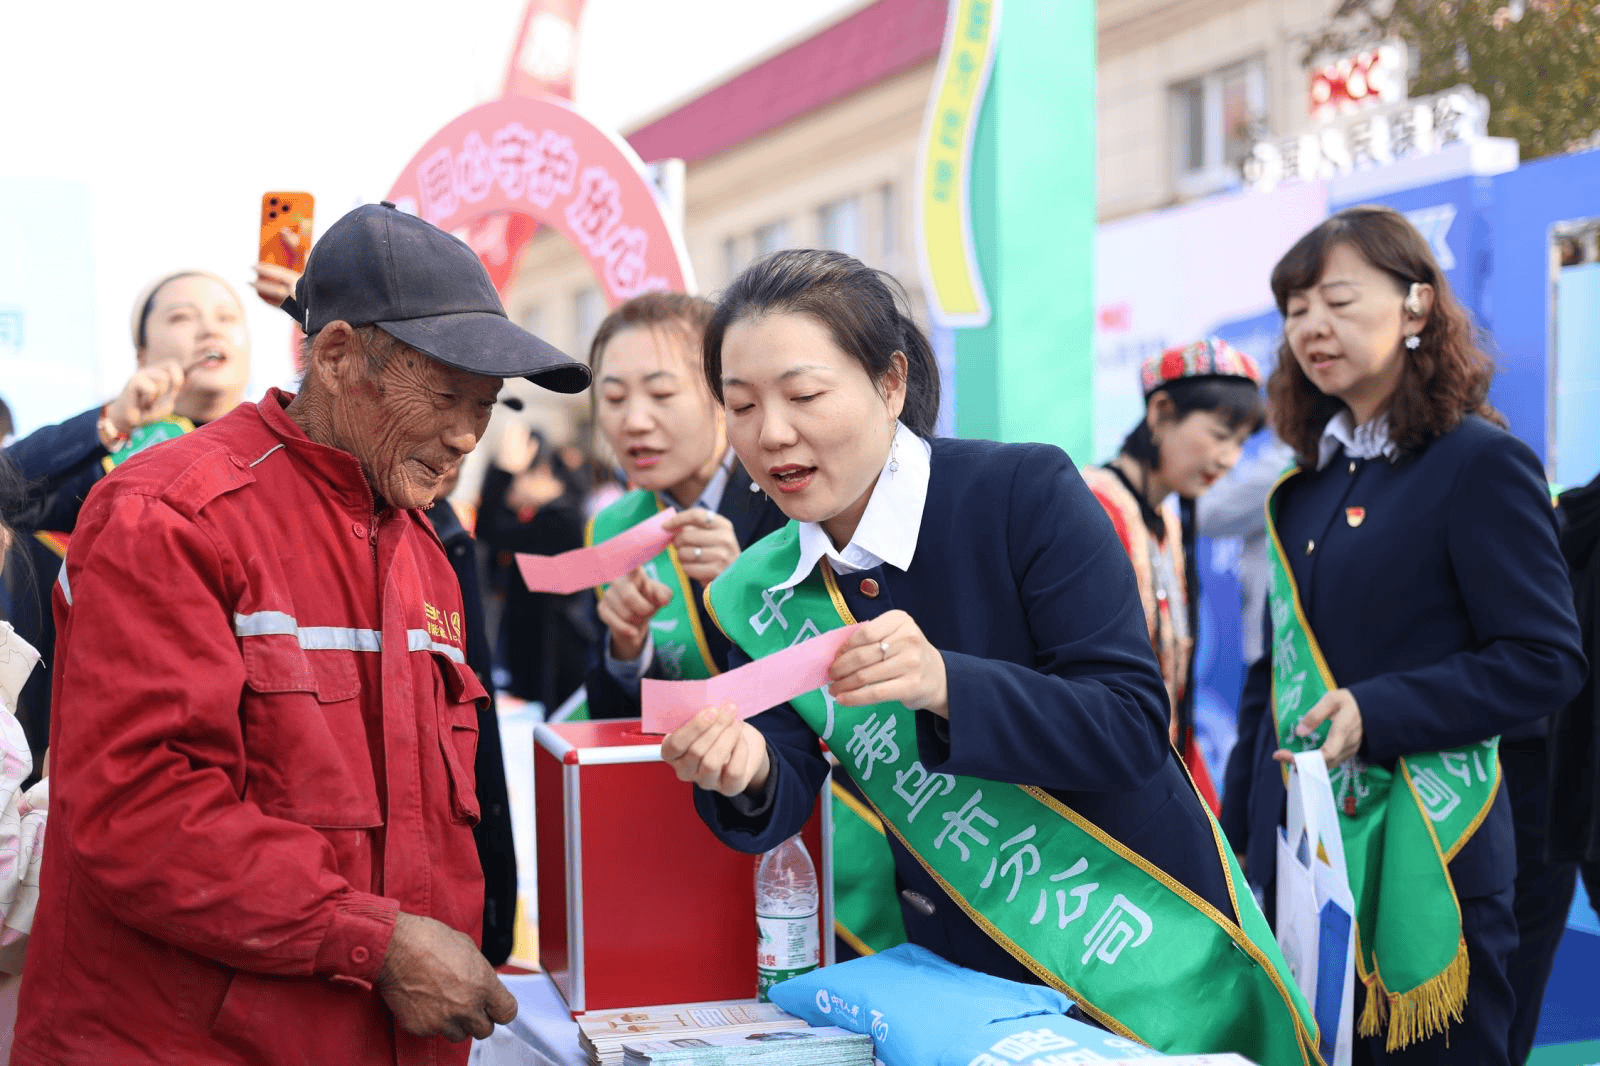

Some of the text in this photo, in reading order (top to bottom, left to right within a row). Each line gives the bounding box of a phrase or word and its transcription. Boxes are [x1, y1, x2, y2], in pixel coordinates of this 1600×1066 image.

[748, 583, 1154, 966] 中寿乌市分公司
[1411, 736, 1499, 823] 公司
